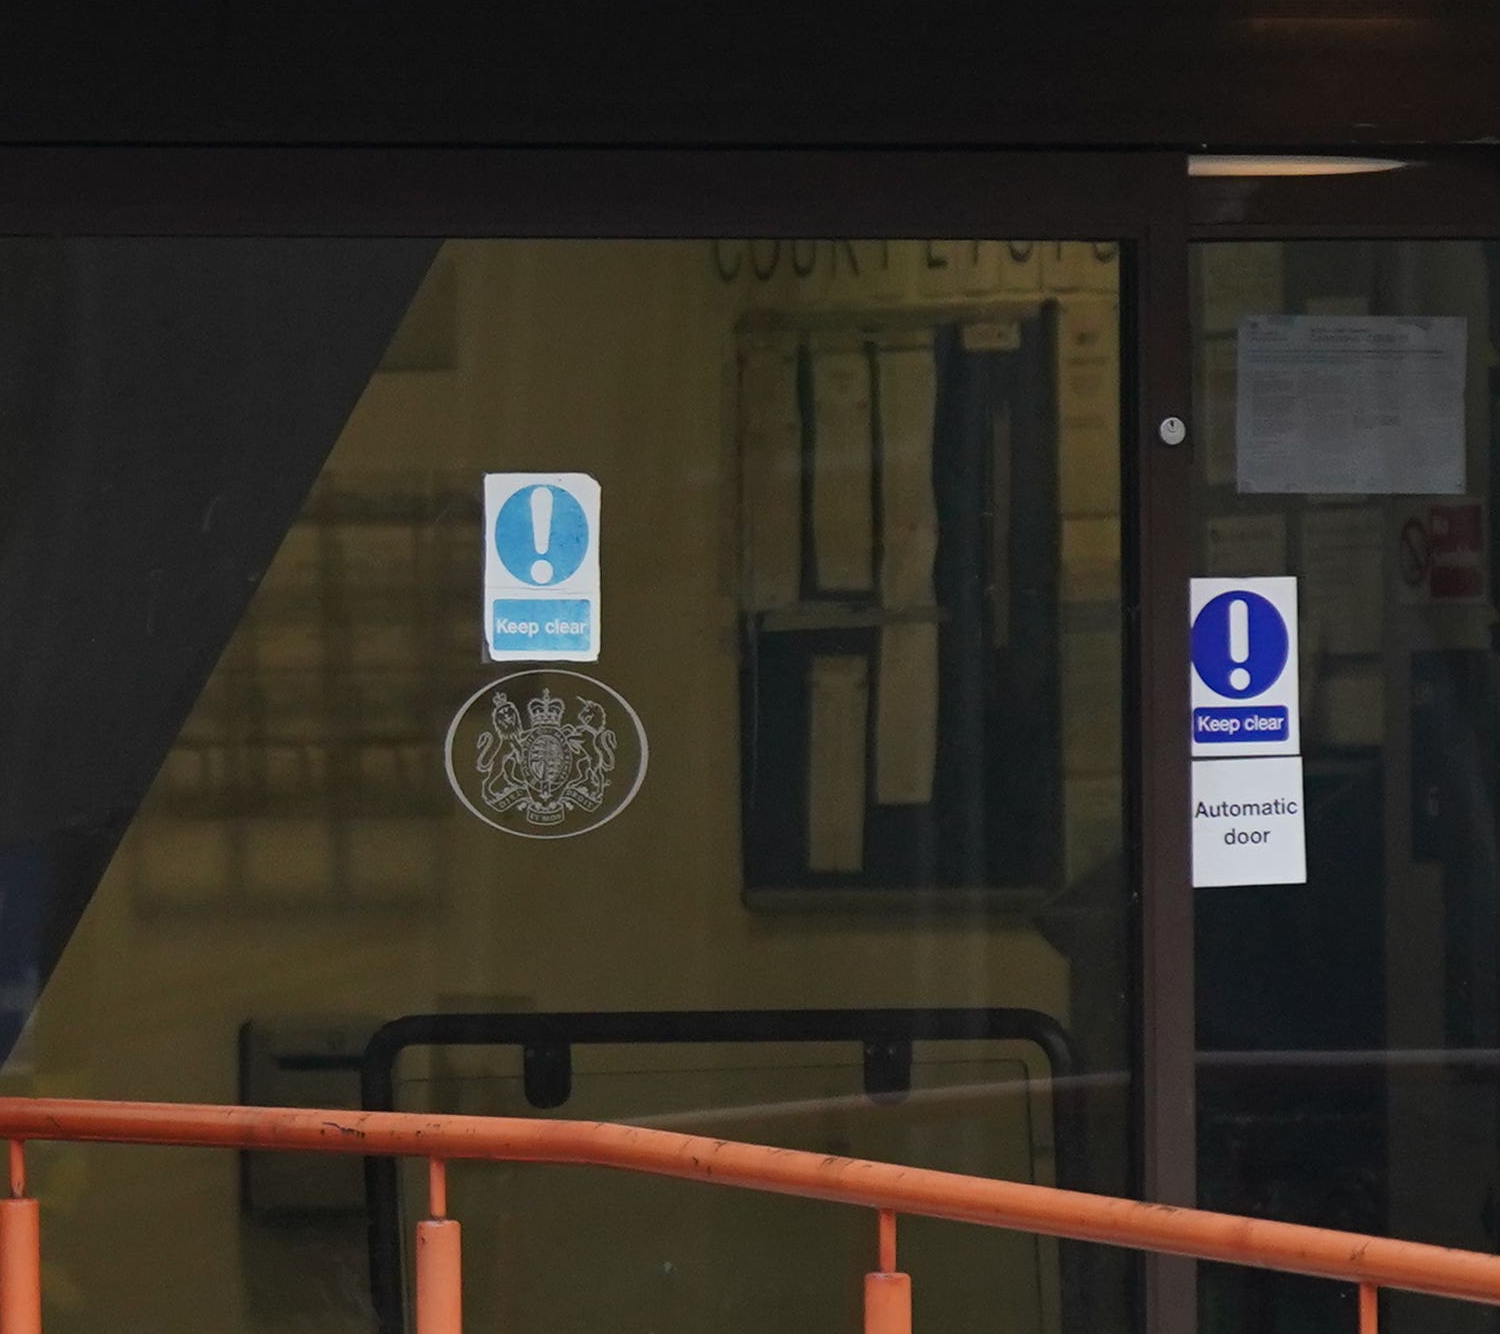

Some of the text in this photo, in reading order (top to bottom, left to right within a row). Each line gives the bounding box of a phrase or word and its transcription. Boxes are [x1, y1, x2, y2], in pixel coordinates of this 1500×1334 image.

[495, 618, 587, 637] Keep clear
[1197, 714, 1285, 736] Keep clear
[1194, 798, 1299, 819] Automatic
[1223, 828, 1271, 846] door
